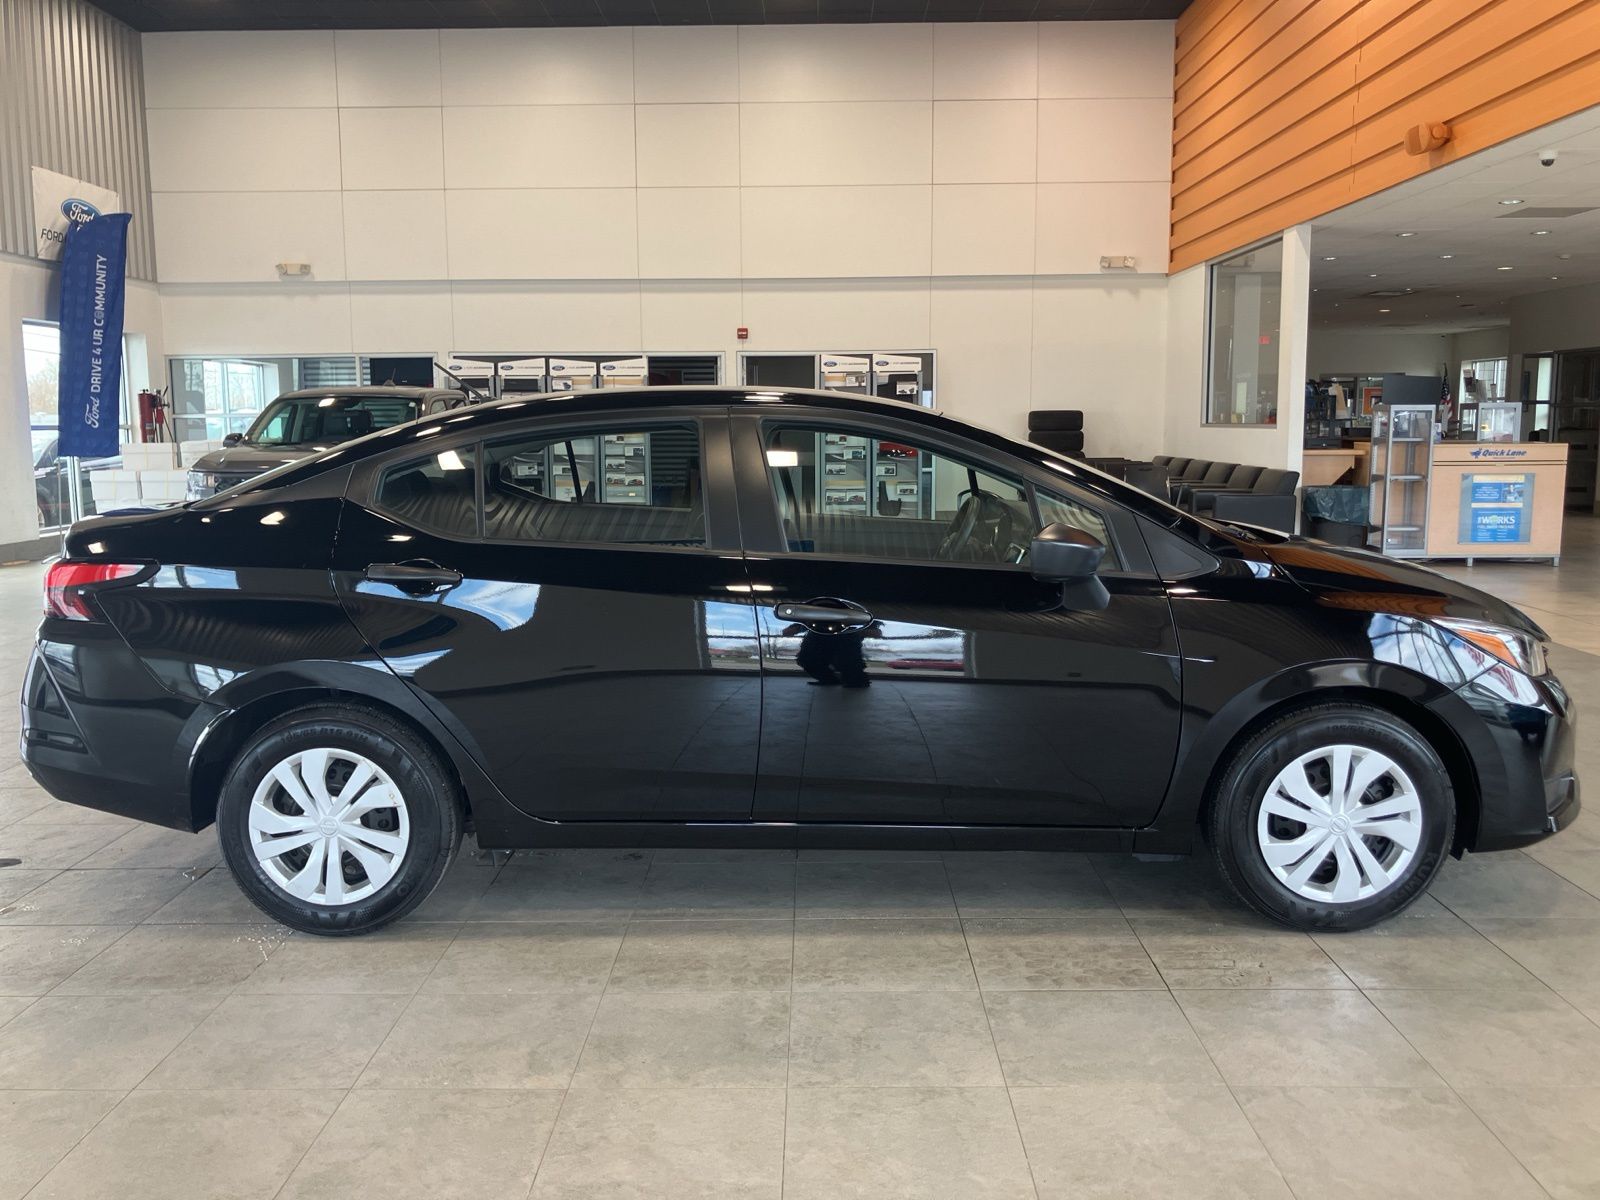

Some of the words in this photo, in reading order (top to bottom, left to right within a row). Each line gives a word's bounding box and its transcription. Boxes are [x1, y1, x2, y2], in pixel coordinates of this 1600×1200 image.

[70, 202, 95, 223] Ford
[40, 228, 64, 243] FORD
[93, 254, 107, 327] COMMUNITY
[92, 329, 104, 346] UR
[92, 346, 103, 355] 4
[90, 357, 102, 393] DRIVE
[85, 396, 100, 429] Ford
[1482, 449, 1505, 457] Quick
